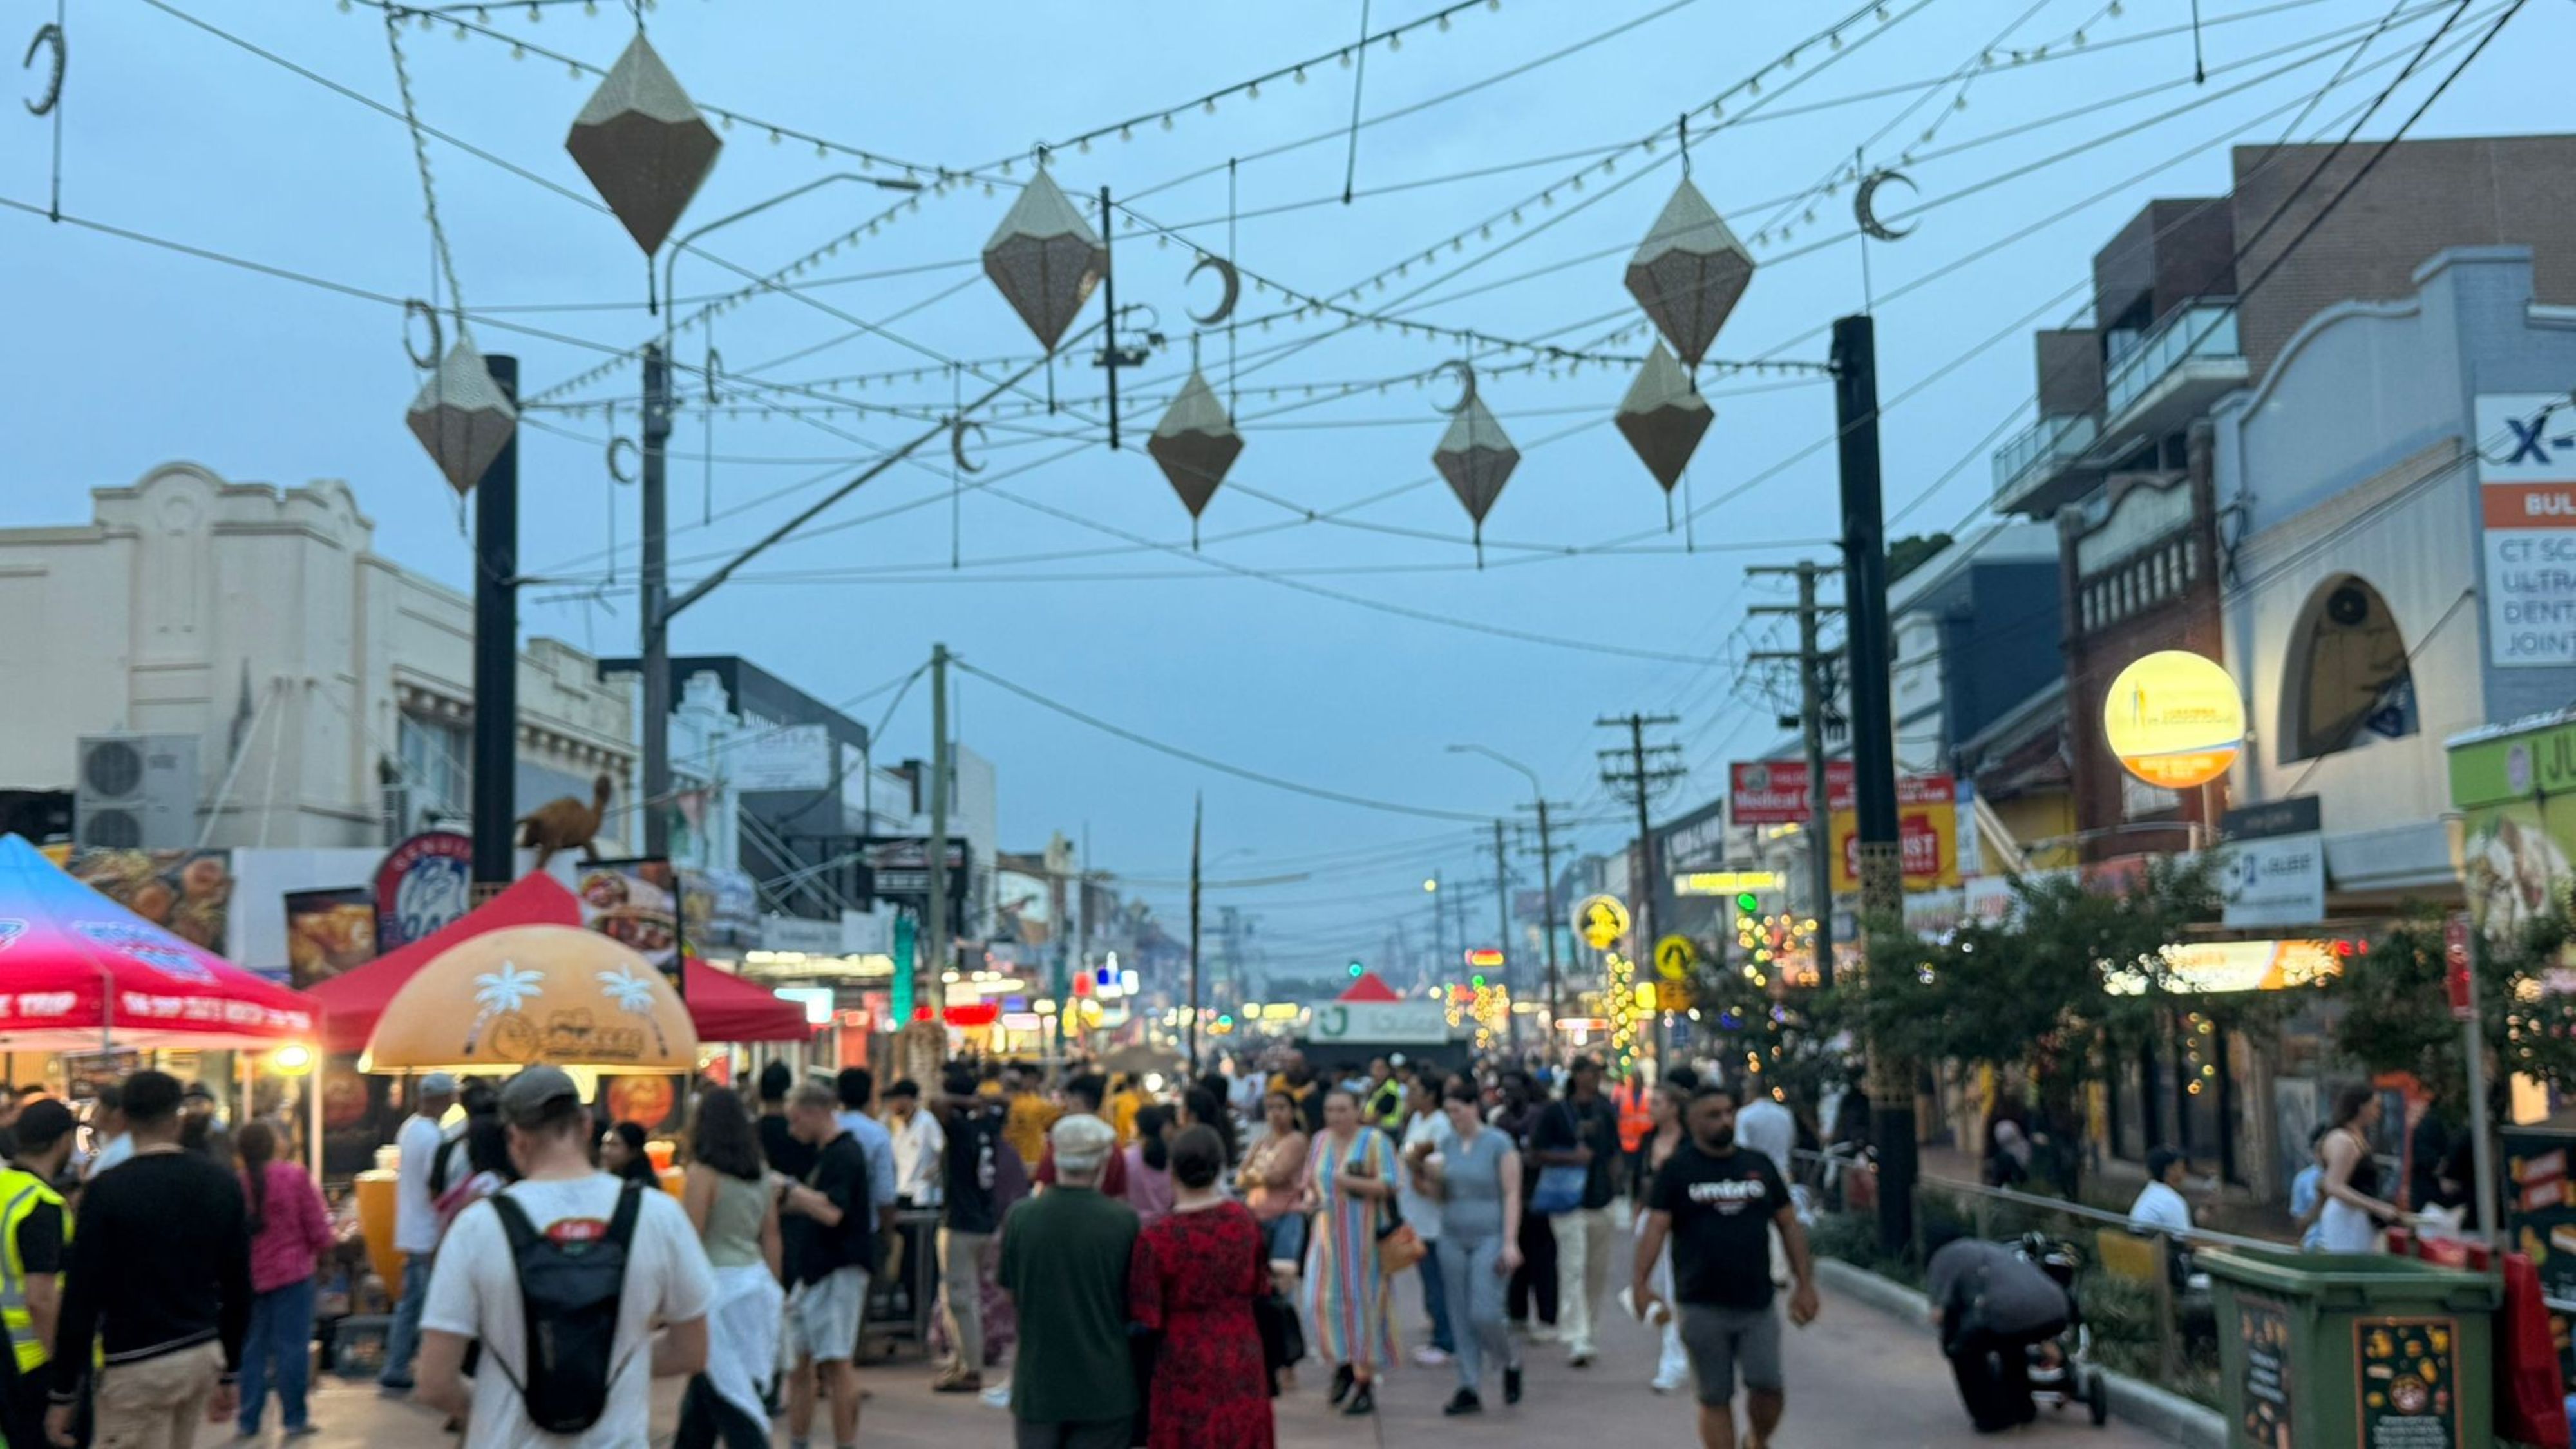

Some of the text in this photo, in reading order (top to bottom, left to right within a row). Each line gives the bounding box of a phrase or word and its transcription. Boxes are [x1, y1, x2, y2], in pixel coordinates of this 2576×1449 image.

[2524, 492, 2576, 515] BUL
[2499, 536, 2576, 562] CT SC
[1688, 1179, 1766, 1202] umbro
